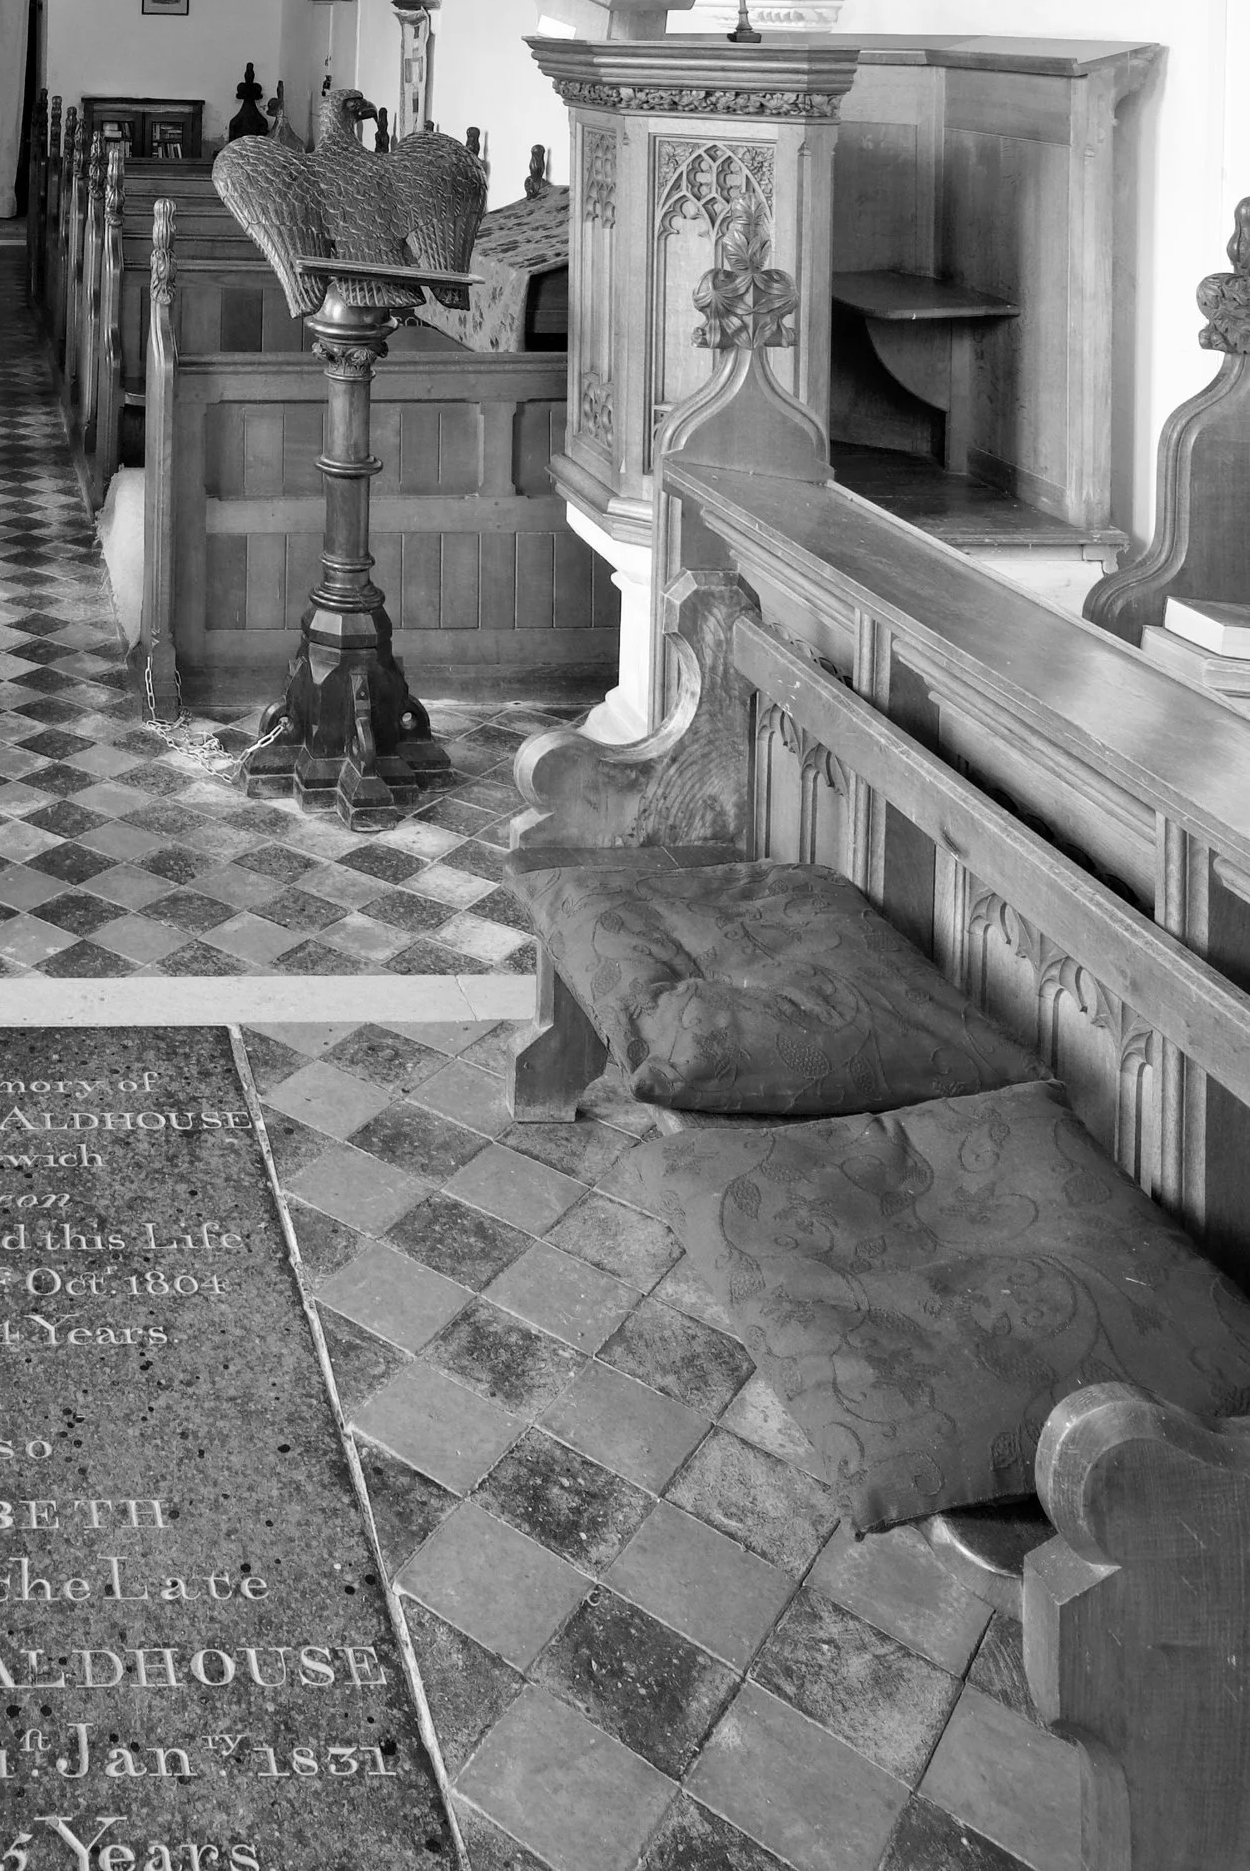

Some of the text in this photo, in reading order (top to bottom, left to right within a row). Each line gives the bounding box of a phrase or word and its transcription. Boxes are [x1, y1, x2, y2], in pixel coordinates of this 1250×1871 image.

[117, 1070, 158, 1093] of
[42, 1223, 126, 1250] this
[141, 1222, 244, 1250] Life
[123, 1271, 228, 1296] 1804
[96, 1556, 270, 1601] Late
[252, 1744, 398, 1778] 1831
